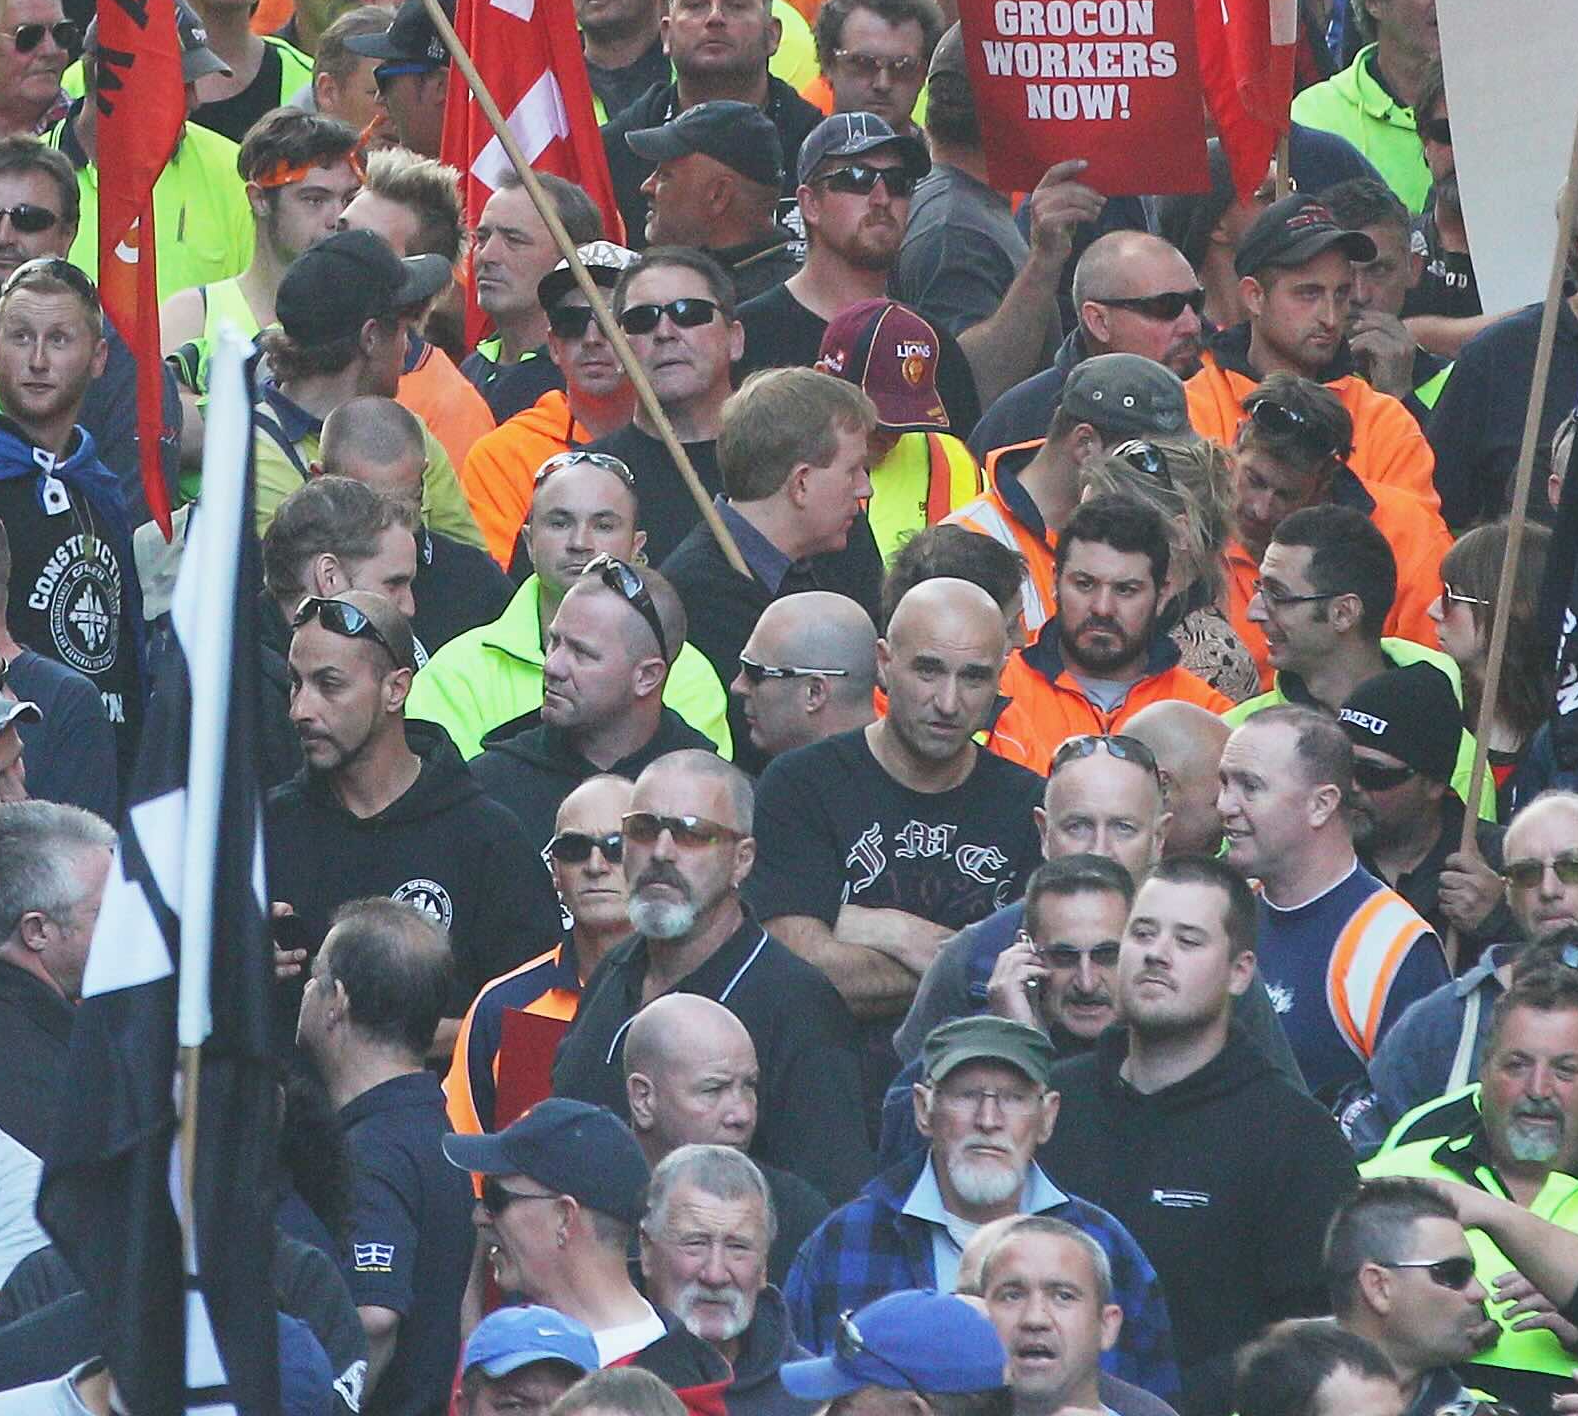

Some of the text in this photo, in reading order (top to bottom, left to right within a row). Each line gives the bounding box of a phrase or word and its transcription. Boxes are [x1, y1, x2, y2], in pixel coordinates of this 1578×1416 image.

[994, 0, 1155, 37] GROCON
[982, 40, 1179, 78] WORKERS
[1025, 84, 1131, 121] NOW!
